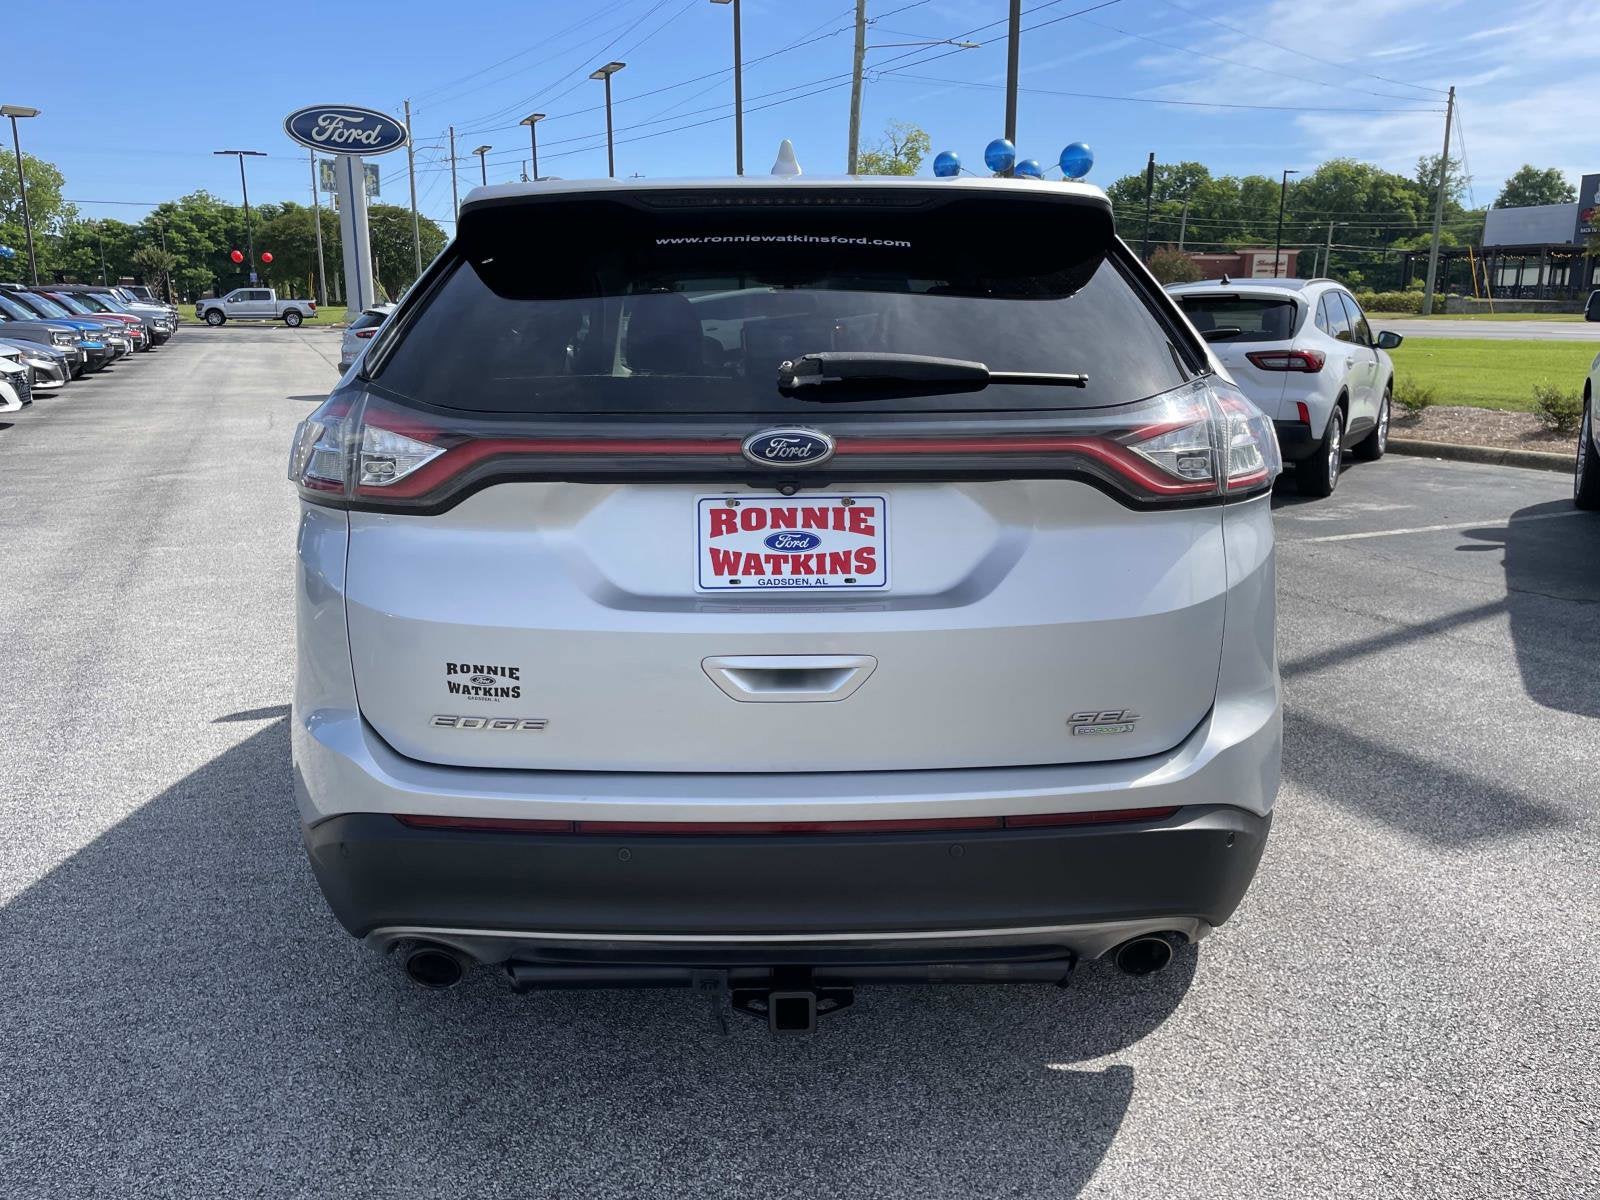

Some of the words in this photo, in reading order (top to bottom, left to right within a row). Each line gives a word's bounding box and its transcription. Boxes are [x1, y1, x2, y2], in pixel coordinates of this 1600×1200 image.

[311, 113, 382, 145] Ford
[655, 234, 912, 248] www.ronniewatkinsford.com
[765, 437, 812, 458] Ford
[709, 506, 876, 539] RONNIE
[775, 533, 809, 548] Ford
[709, 546, 877, 577] WATKINS
[757, 577, 813, 587] GADSDEN,
[814, 577, 829, 586] AL
[446, 662, 520, 681] RONNIE
[447, 680, 521, 699] WATKINS
[429, 714, 548, 731] EDGE
[1067, 709, 1144, 725] SEL
